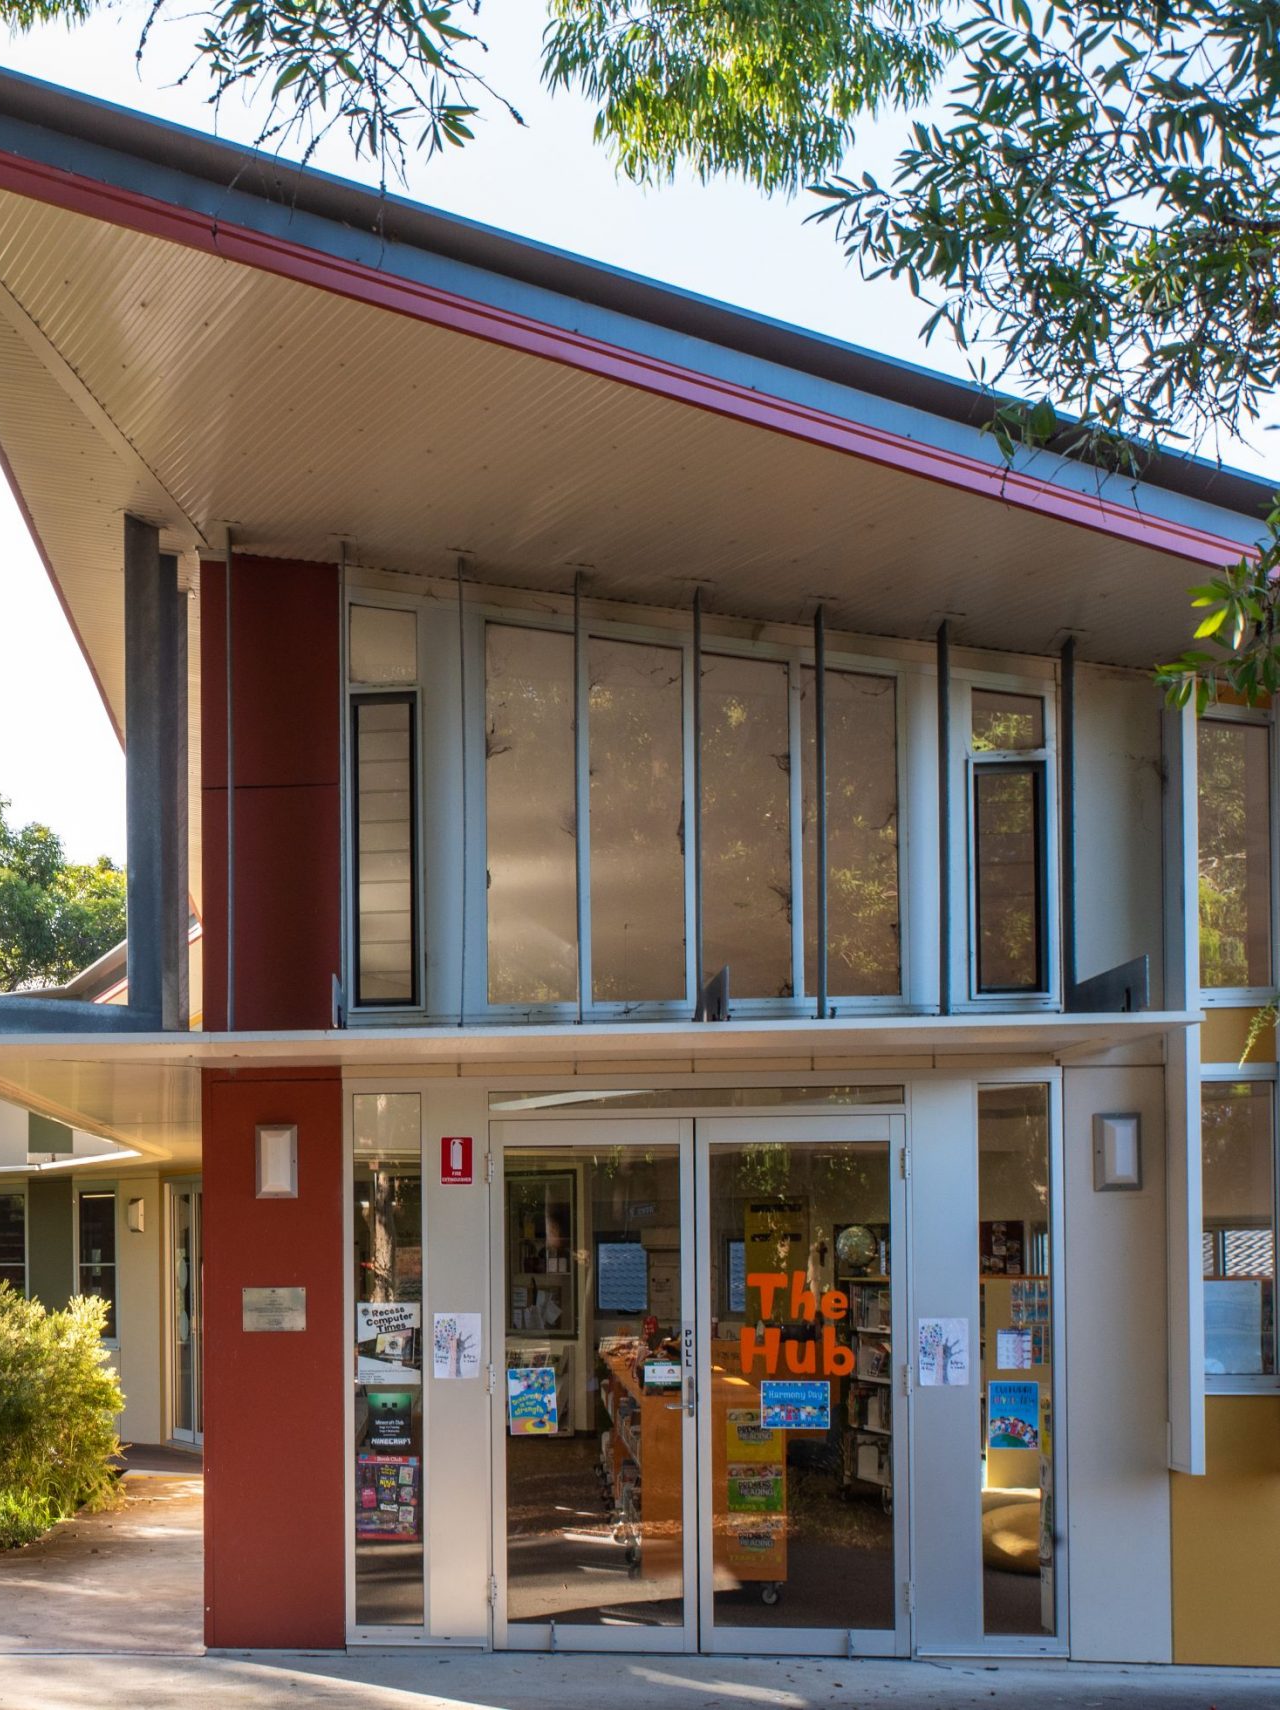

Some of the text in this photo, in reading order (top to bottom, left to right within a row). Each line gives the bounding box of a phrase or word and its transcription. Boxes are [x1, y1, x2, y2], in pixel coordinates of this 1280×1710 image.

[746, 1270, 848, 1322] The
[371, 1307, 405, 1317] Recess
[366, 1313, 413, 1327] Computer
[376, 1323, 406, 1333] Times
[740, 1324, 855, 1376] Hub
[768, 1390, 823, 1400] Harmony Day
[371, 1437, 411, 1445] MINECRAFT
